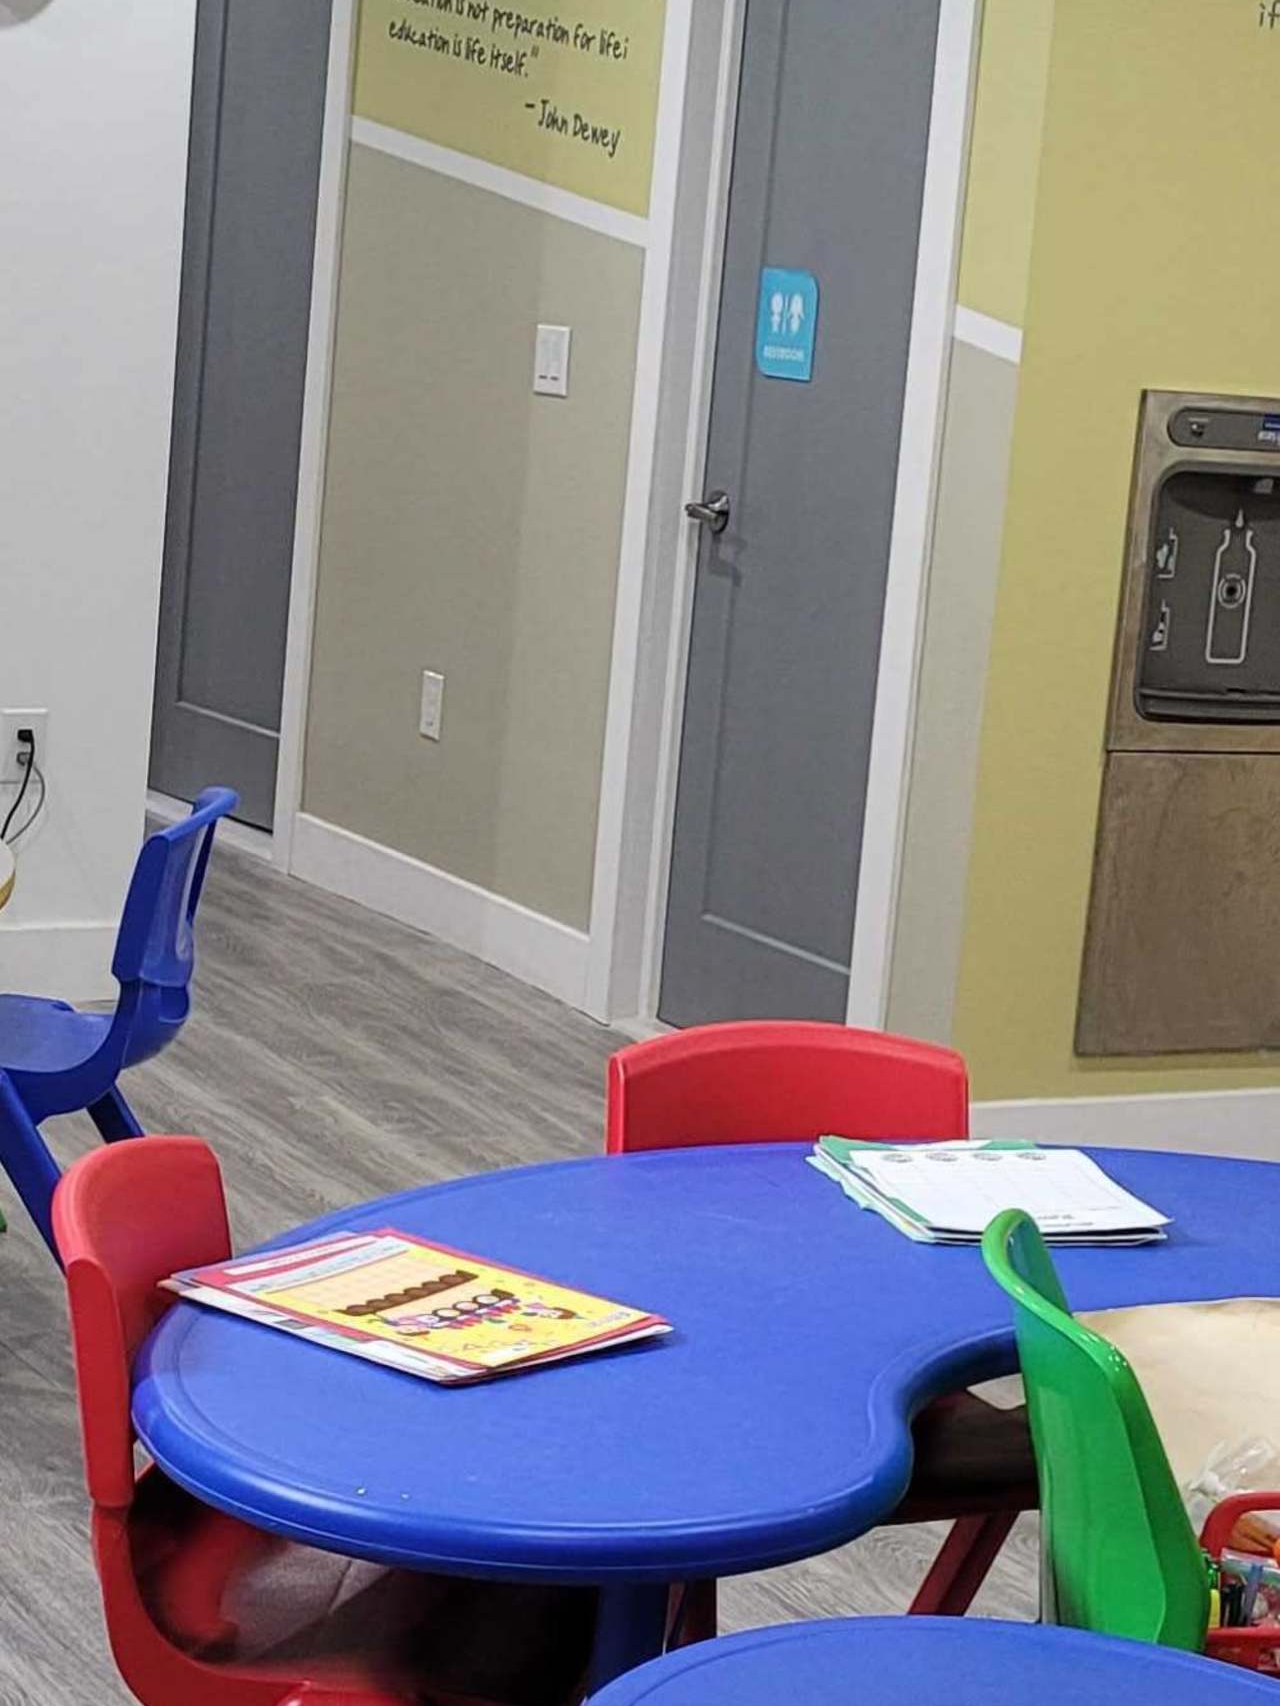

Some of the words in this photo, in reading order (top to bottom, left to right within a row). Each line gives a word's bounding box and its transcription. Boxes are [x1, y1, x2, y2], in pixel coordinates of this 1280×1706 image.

[388, 19, 450, 55] education
[453, 34, 462, 57] is
[465, 37, 485, 66] life
[467, 1, 489, 23] not
[492, 7, 569, 44] preparation
[573, 24, 596, 52] for
[538, 99, 569, 136] John
[573, 113, 621, 158] Dewey
